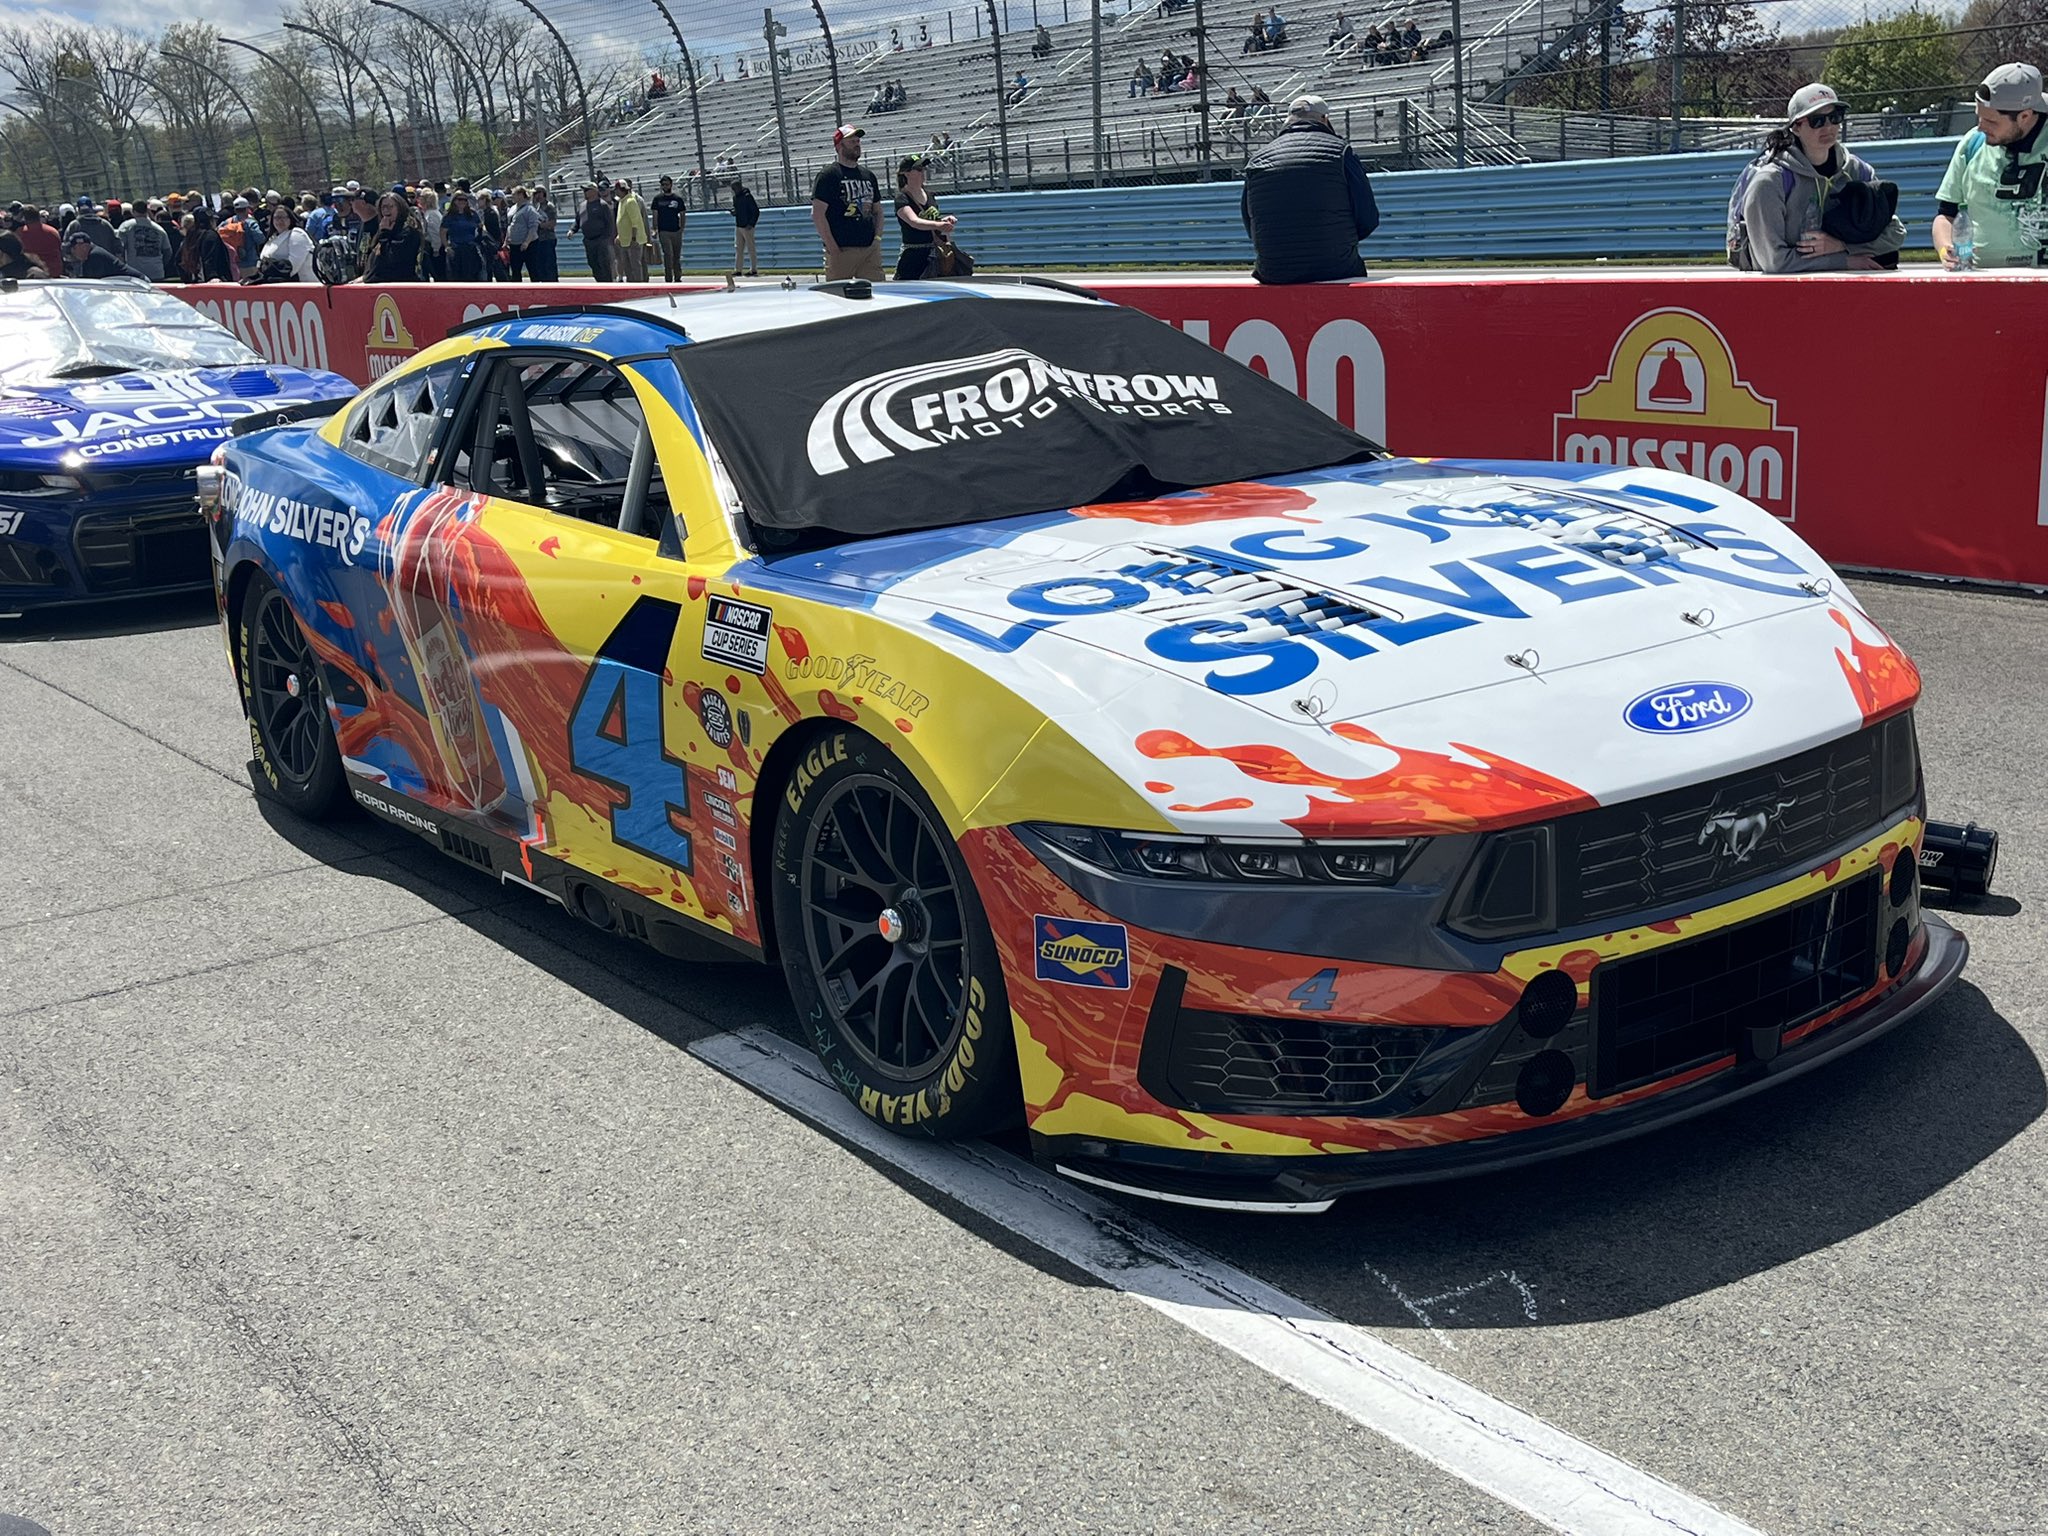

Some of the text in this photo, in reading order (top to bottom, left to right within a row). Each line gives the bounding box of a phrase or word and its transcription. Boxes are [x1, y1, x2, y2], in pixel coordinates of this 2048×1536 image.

[841, 180, 873, 202] TEXAS
[234, 484, 276, 529] JOHN
[269, 495, 371, 566] SILVER'S
[726, 604, 762, 631] NASCAR
[711, 629, 759, 657] CUP SERIES
[1649, 688, 1732, 728] Ford
[566, 593, 695, 877] 4
[785, 733, 848, 815] EAGLE
[355, 789, 438, 835] FORD RACING
[1040, 942, 1123, 967] SUNOCO
[1286, 967, 1340, 1012] 4
